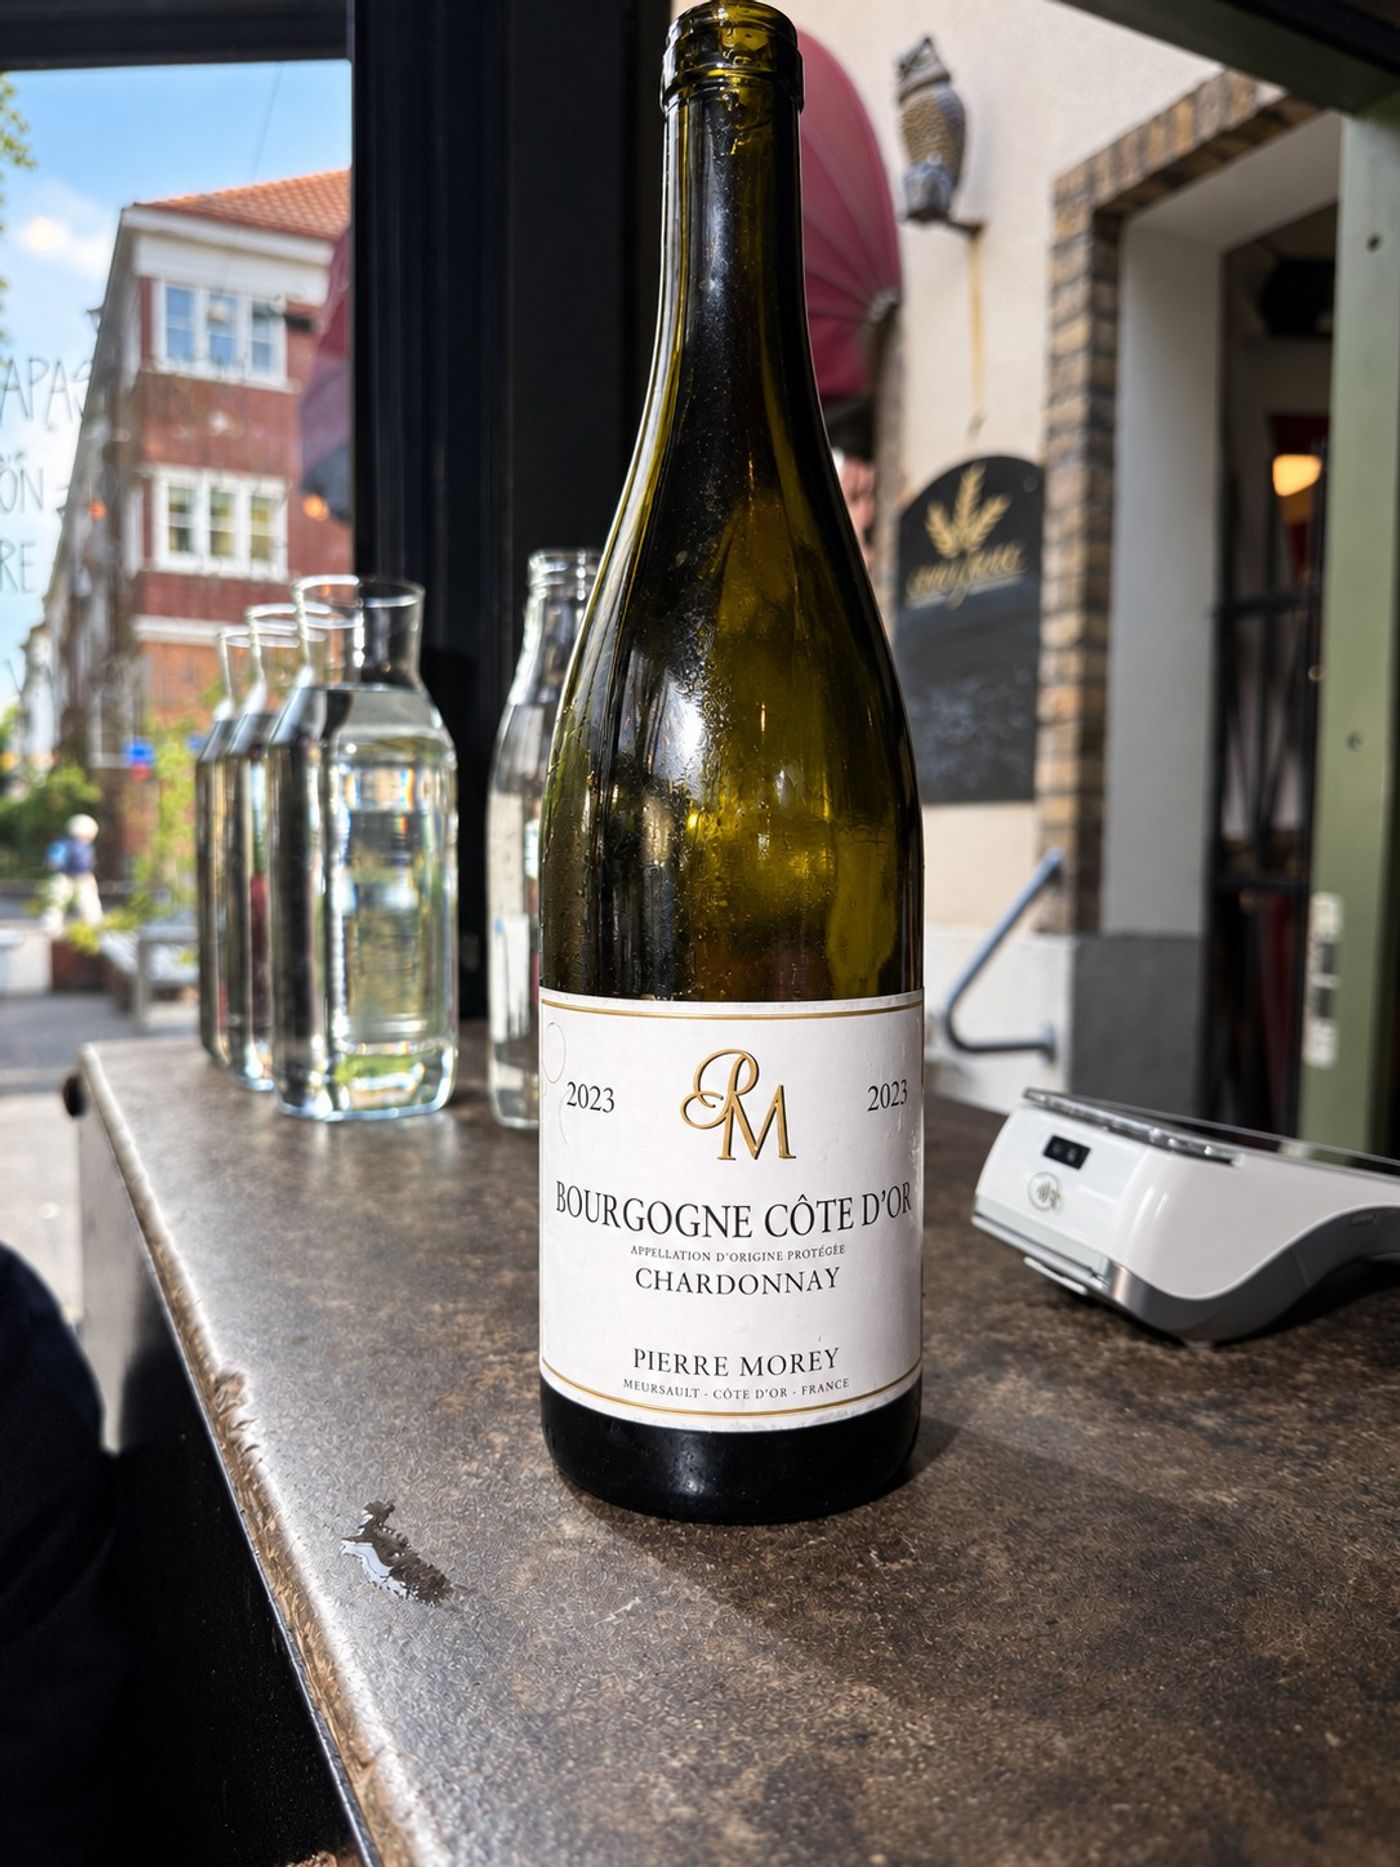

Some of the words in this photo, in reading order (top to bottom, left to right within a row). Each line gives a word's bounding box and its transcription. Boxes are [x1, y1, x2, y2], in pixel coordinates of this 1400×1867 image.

[566, 1081, 615, 1113] 2023
[867, 1079, 908, 1112] 2023
[556, 1180, 752, 1238] BOURGOGNE
[763, 1194, 855, 1237] CÔTE
[630, 1245, 711, 1262] APPELLATION
[716, 1250, 783, 1263] D'ORIGINE
[787, 1243, 845, 1261] PROTÉGÉE
[635, 1266, 841, 1295] CHARDONNAY
[634, 1348, 729, 1377] PIERRE
[739, 1347, 840, 1377] MOREY
[623, 1378, 700, 1399] MEURSAULT
[712, 1387, 751, 1400] CÔTE
[801, 1377, 850, 1397] FRANCE
